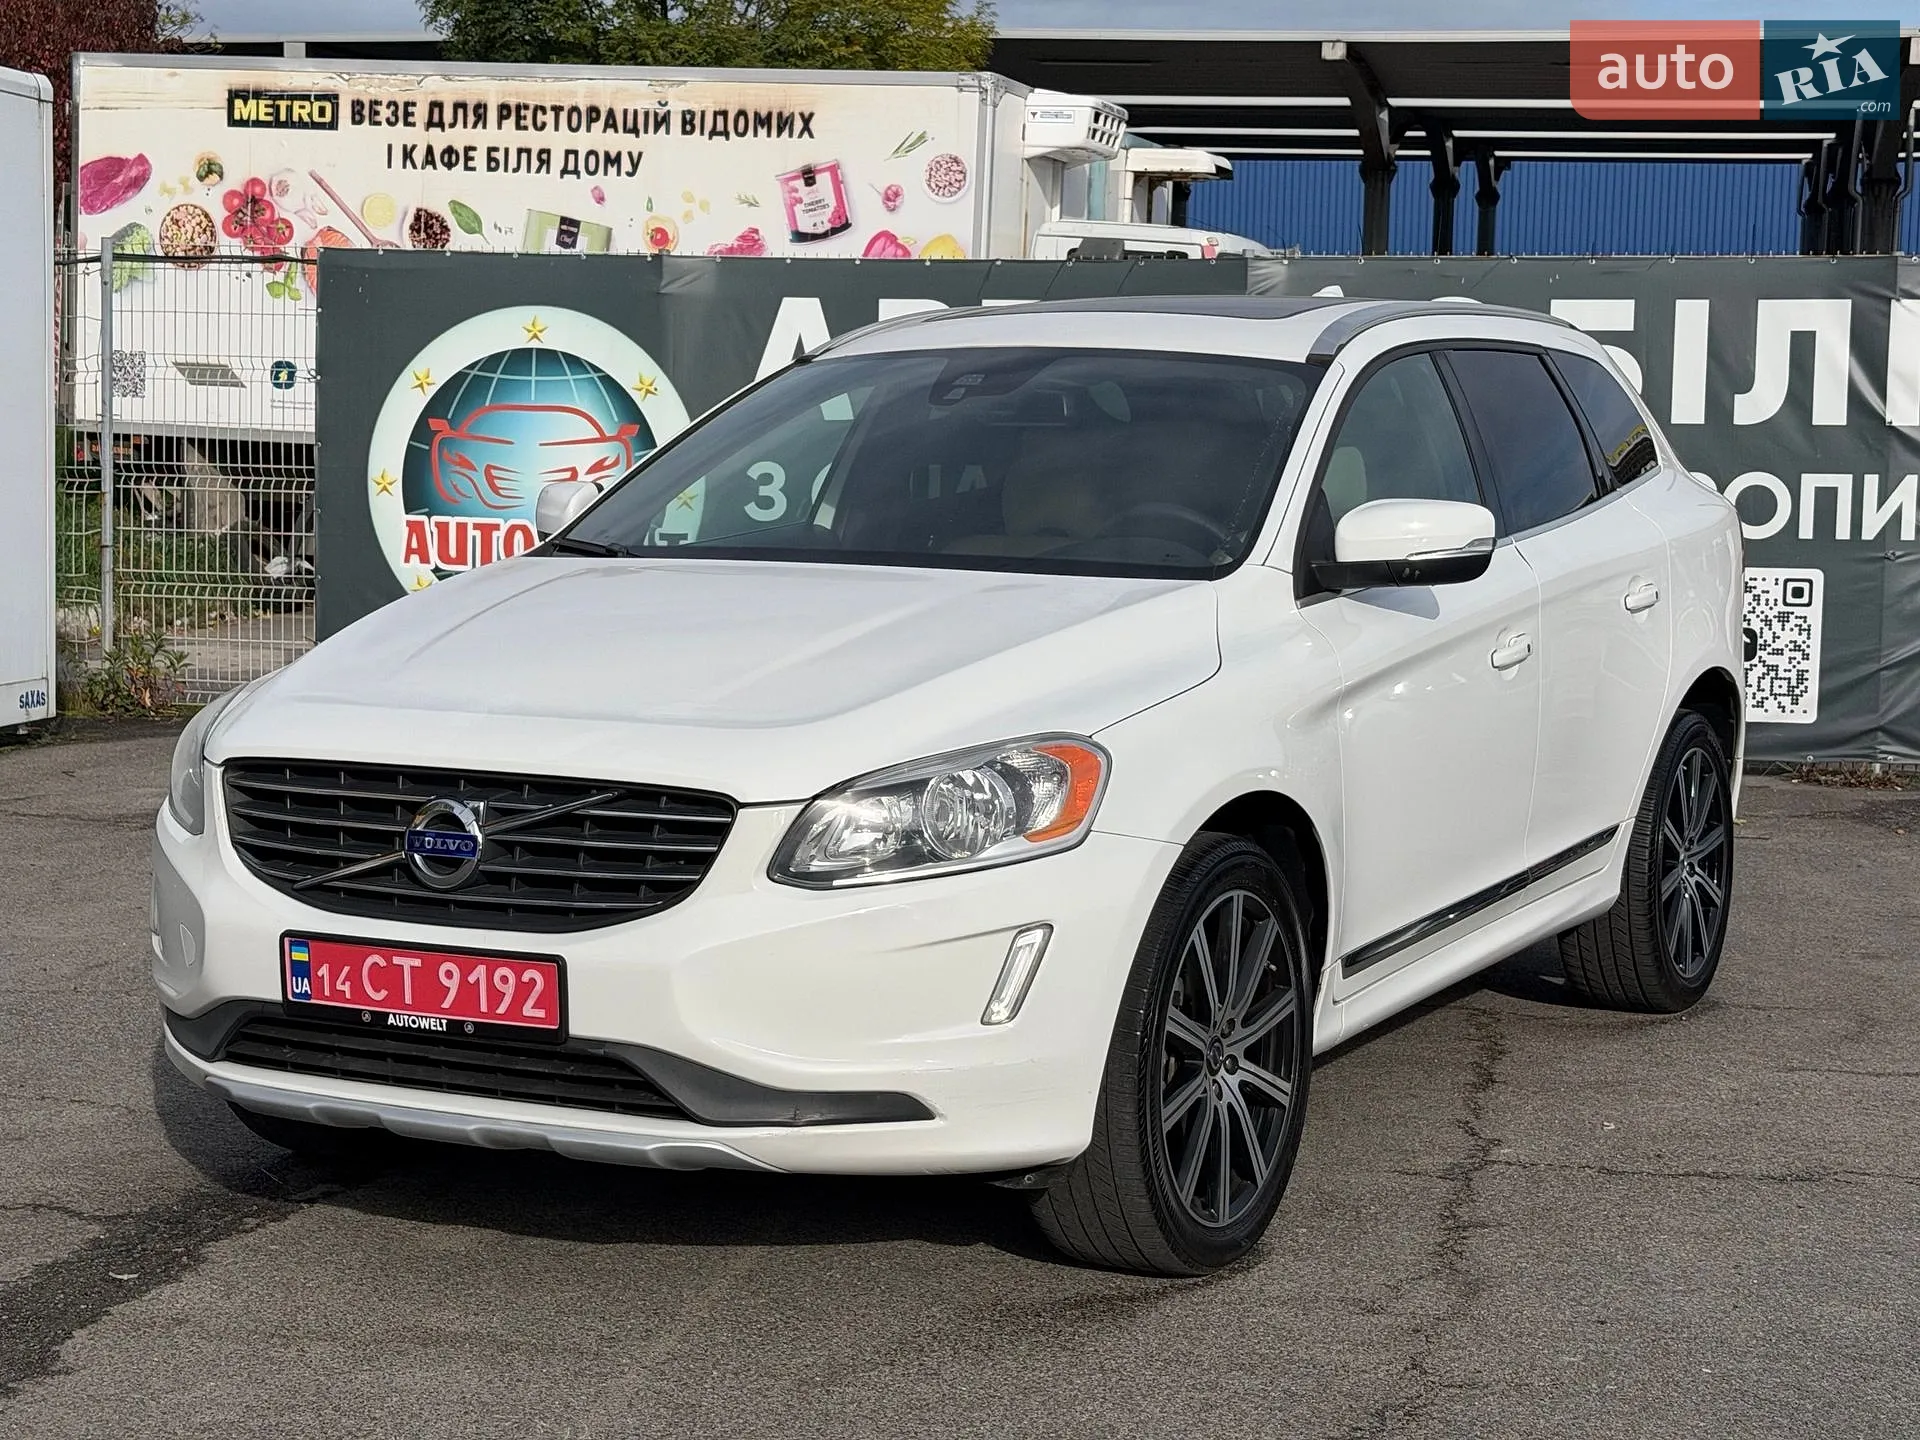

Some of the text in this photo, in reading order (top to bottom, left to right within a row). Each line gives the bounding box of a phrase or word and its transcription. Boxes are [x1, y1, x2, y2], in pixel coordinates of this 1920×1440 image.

[233, 98, 332, 124] METRO
[350, 99, 815, 141] ВЕЗЕ ДЛЯ РЕСТОРАЦІЙ ВІДОМИХ
[386, 143, 644, 179] І КАФЕ БІЛЯ ДОМУ
[1689, 471, 1919, 541] ОПИ
[19, 690, 46, 709] SAXAS
[410, 835, 474, 852] VOLVO
[291, 976, 312, 995] UA
[438, 961, 546, 1019] 9192
[387, 1013, 448, 1031] AUTOWELT
